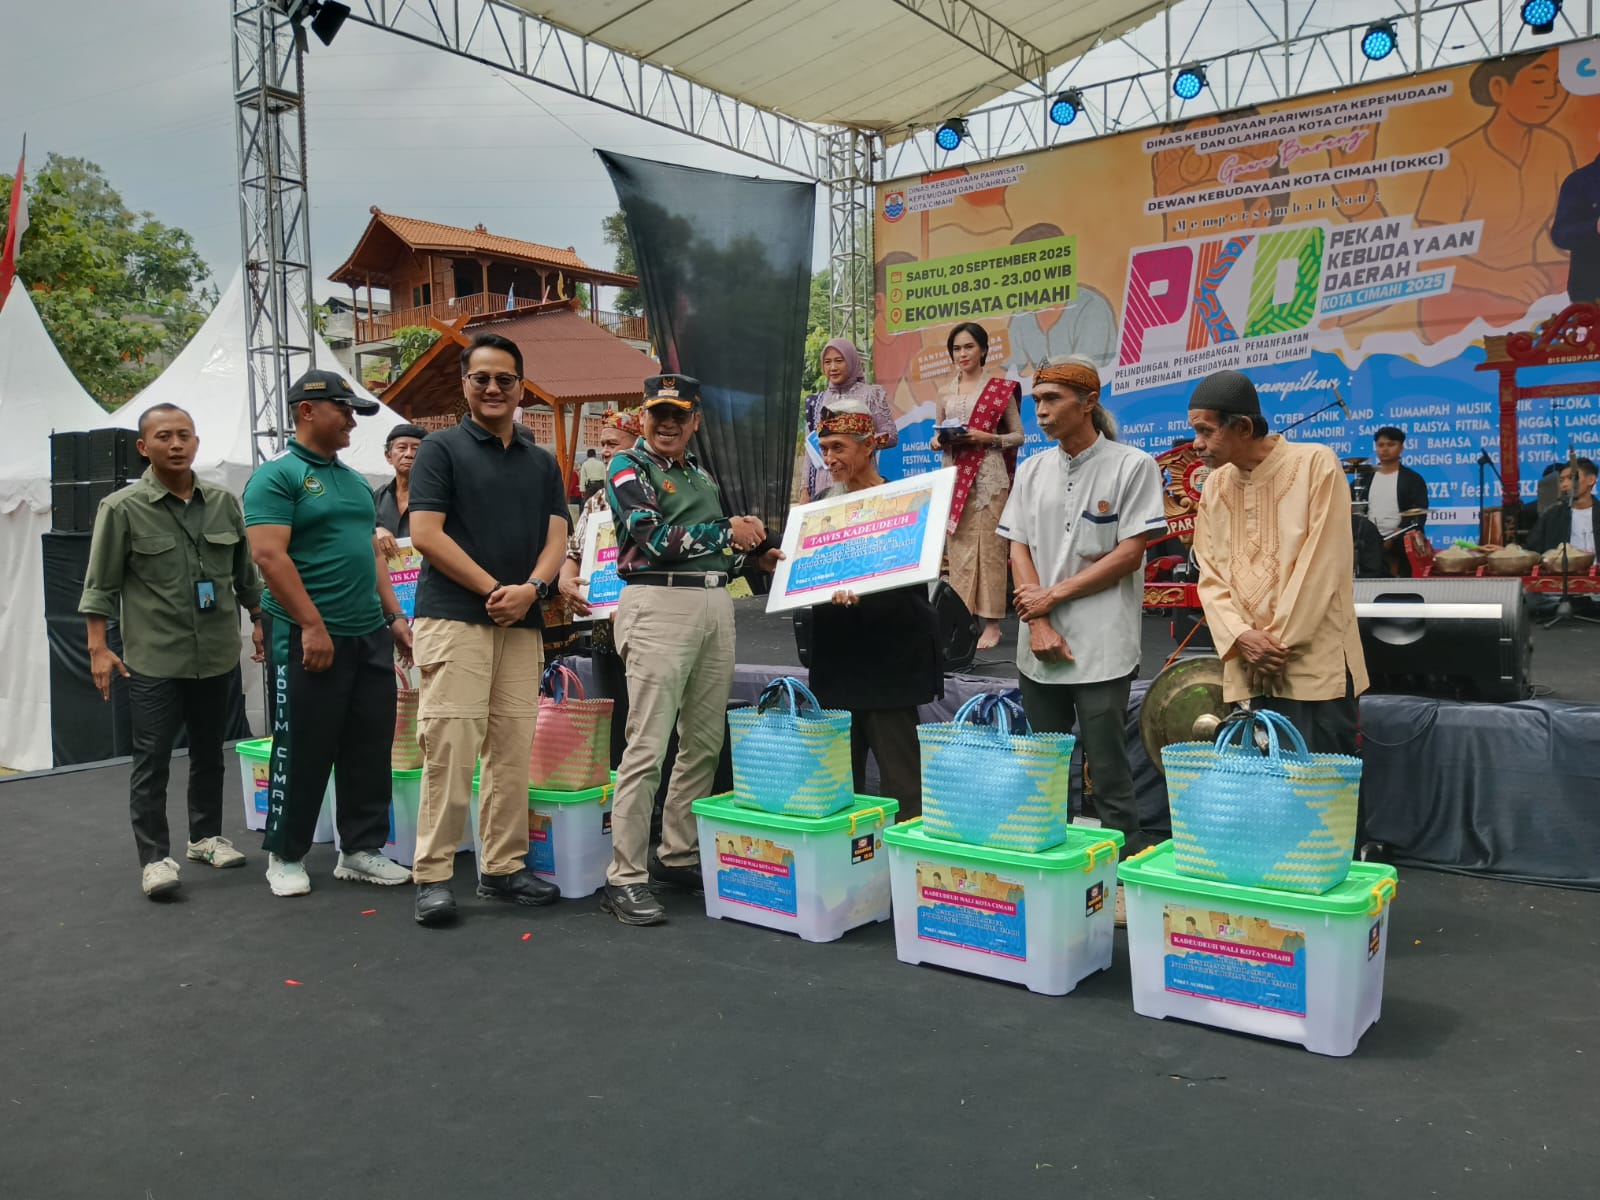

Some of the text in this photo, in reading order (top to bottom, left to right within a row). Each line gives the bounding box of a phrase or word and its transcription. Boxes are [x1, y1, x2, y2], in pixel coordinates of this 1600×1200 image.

[1146, 84, 1448, 149] DINAS KEBUDAYAAN PARIWISATA KEPEMUDAAN
[1200, 109, 1382, 151] DAN OLAHRAGA KOTA CIMAHI
[1148, 153, 1444, 211] DEWAN KEBUDAYAAN KOTA CIMAHI (DKKC)
[1327, 230, 1475, 270] KEBUDAYAAN
[1329, 222, 1400, 249] PEKAN
[906, 245, 1071, 284] SABTU, 20 SEPTEMBER 2025
[906, 283, 949, 301] PUKUL
[951, 277, 991, 296] 08.30
[1001, 271, 1041, 288] 23.00
[1044, 264, 1072, 280] WIB
[1324, 260, 1410, 292] DAERAH
[905, 285, 1070, 323] EKOWISATA CIMAHI
[1119, 226, 1325, 367] PKD
[1321, 275, 1444, 313] KOTA CIMAHI 2025
[1245, 332, 1309, 351] PEMANFAATAN
[1114, 346, 1308, 391] DAN PEMBINAAN KEBUDAYAAN KOTA CIMAHI
[1123, 422, 1155, 435] RAKYAT
[1390, 403, 1450, 418] LUMAMPAH
[1456, 401, 1492, 415] MUSIK
[902, 453, 931, 465] FESTIVAL
[1302, 426, 1345, 439] MANDIRI
[1413, 420, 1450, 433] RAISYA
[1455, 417, 1490, 431] FITRIA
[1427, 435, 1472, 449] BAHASA
[1527, 450, 1559, 463] SYIFA
[1461, 481, 1490, 498] feat
[810, 515, 910, 546] TAWIS KADEUDEUH
[1167, 517, 1194, 535] PAR
[271, 664, 288, 831] KODIM CIMAHI
[1220, 945, 1239, 954] WALI
[1240, 948, 1261, 958] KOTA
[1262, 951, 1291, 962] CIMAHI
